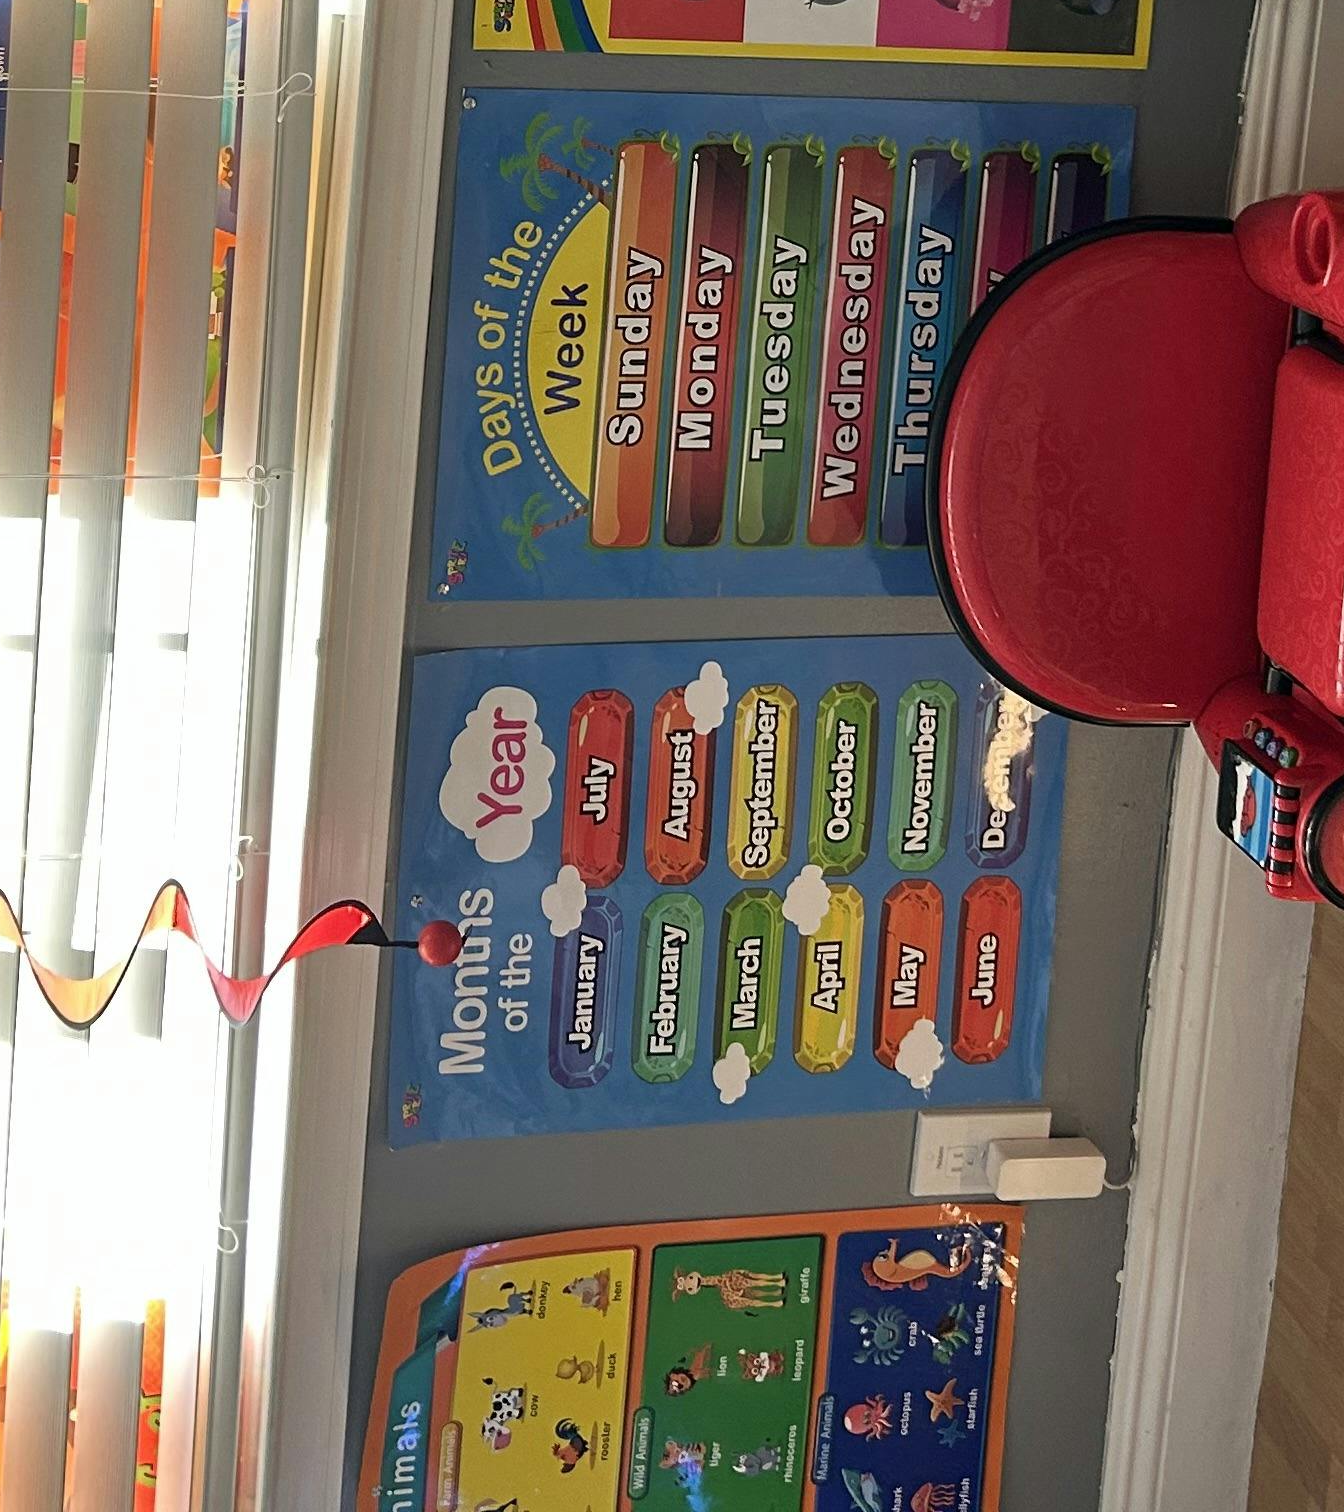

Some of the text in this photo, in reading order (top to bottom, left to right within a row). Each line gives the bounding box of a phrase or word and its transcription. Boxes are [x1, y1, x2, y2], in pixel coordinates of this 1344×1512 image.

[473, 220, 543, 476] Days of the
[544, 284, 588, 415] Week
[607, 247, 663, 447] Sunday
[677, 246, 732, 452] Monday
[750, 236, 807, 461] Tuesday
[820, 195, 885, 501] Wednesday
[893, 225, 953, 474] Thursday
[475, 706, 528, 829] Year
[582, 757, 616, 824] July
[664, 729, 696, 840] August
[742, 698, 778, 868] September
[825, 719, 858, 842] October
[903, 700, 938, 855] November
[439, 888, 494, 1075] Months
[498, 933, 533, 1031] of the
[567, 933, 605, 1052] January
[649, 923, 689, 1055] February
[730, 937, 763, 1031] March
[811, 941, 842, 1012] April
[891, 944, 926, 1009] May
[971, 933, 998, 1007] June
[536, 1280, 549, 1319] donkey
[613, 1281, 622, 1301] hen
[798, 1267, 811, 1303] giraffe
[607, 1353, 616, 1379] duck
[717, 1356, 728, 1377] lion
[793, 1339, 806, 1381] leopard
[908, 1322, 917, 1347] crab
[974, 1304, 985, 1356] sea turtle
[529, 1395, 539, 1417] cow
[600, 1422, 611, 1461] rooster
[817, 1395, 835, 1480] Marine Animals
[899, 1392, 912, 1435] octopus
[966, 1388, 979, 1429] starfish
[387, 1401, 420, 1512] nimals
[633, 1417, 650, 1489] Wild Animals
[709, 1441, 722, 1467] tiger
[783, 1424, 797, 1482] rhinoceros
